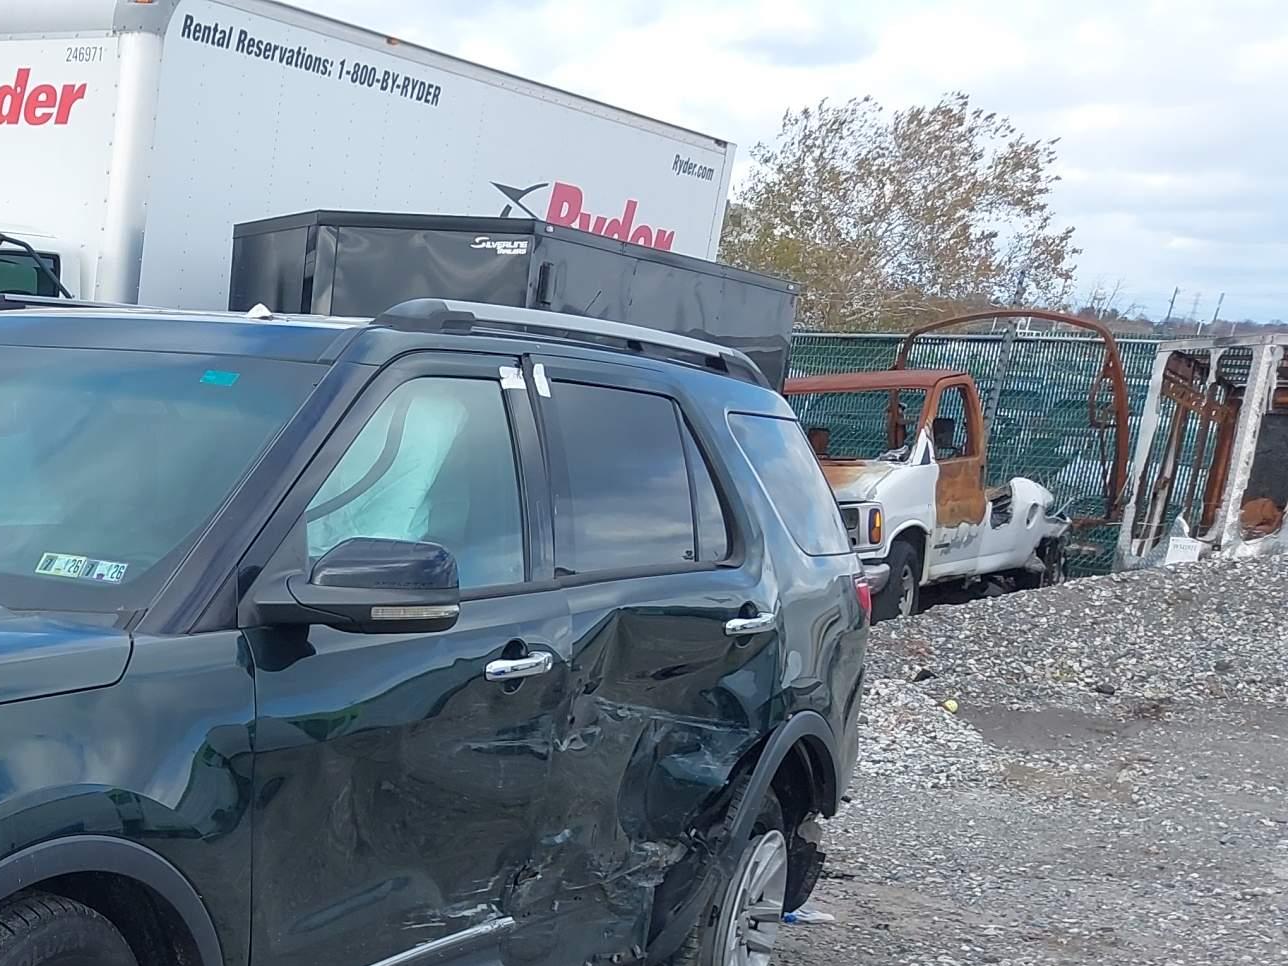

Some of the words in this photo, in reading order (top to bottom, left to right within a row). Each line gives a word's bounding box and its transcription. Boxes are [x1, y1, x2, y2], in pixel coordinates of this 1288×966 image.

[65, 45, 104, 64] 246971
[181, 14, 234, 49] Rental
[236, 27, 334, 77] Reservations:
[337, 56, 443, 107] 1-800-BY-RYDER
[672, 153, 714, 182] Ryder.com
